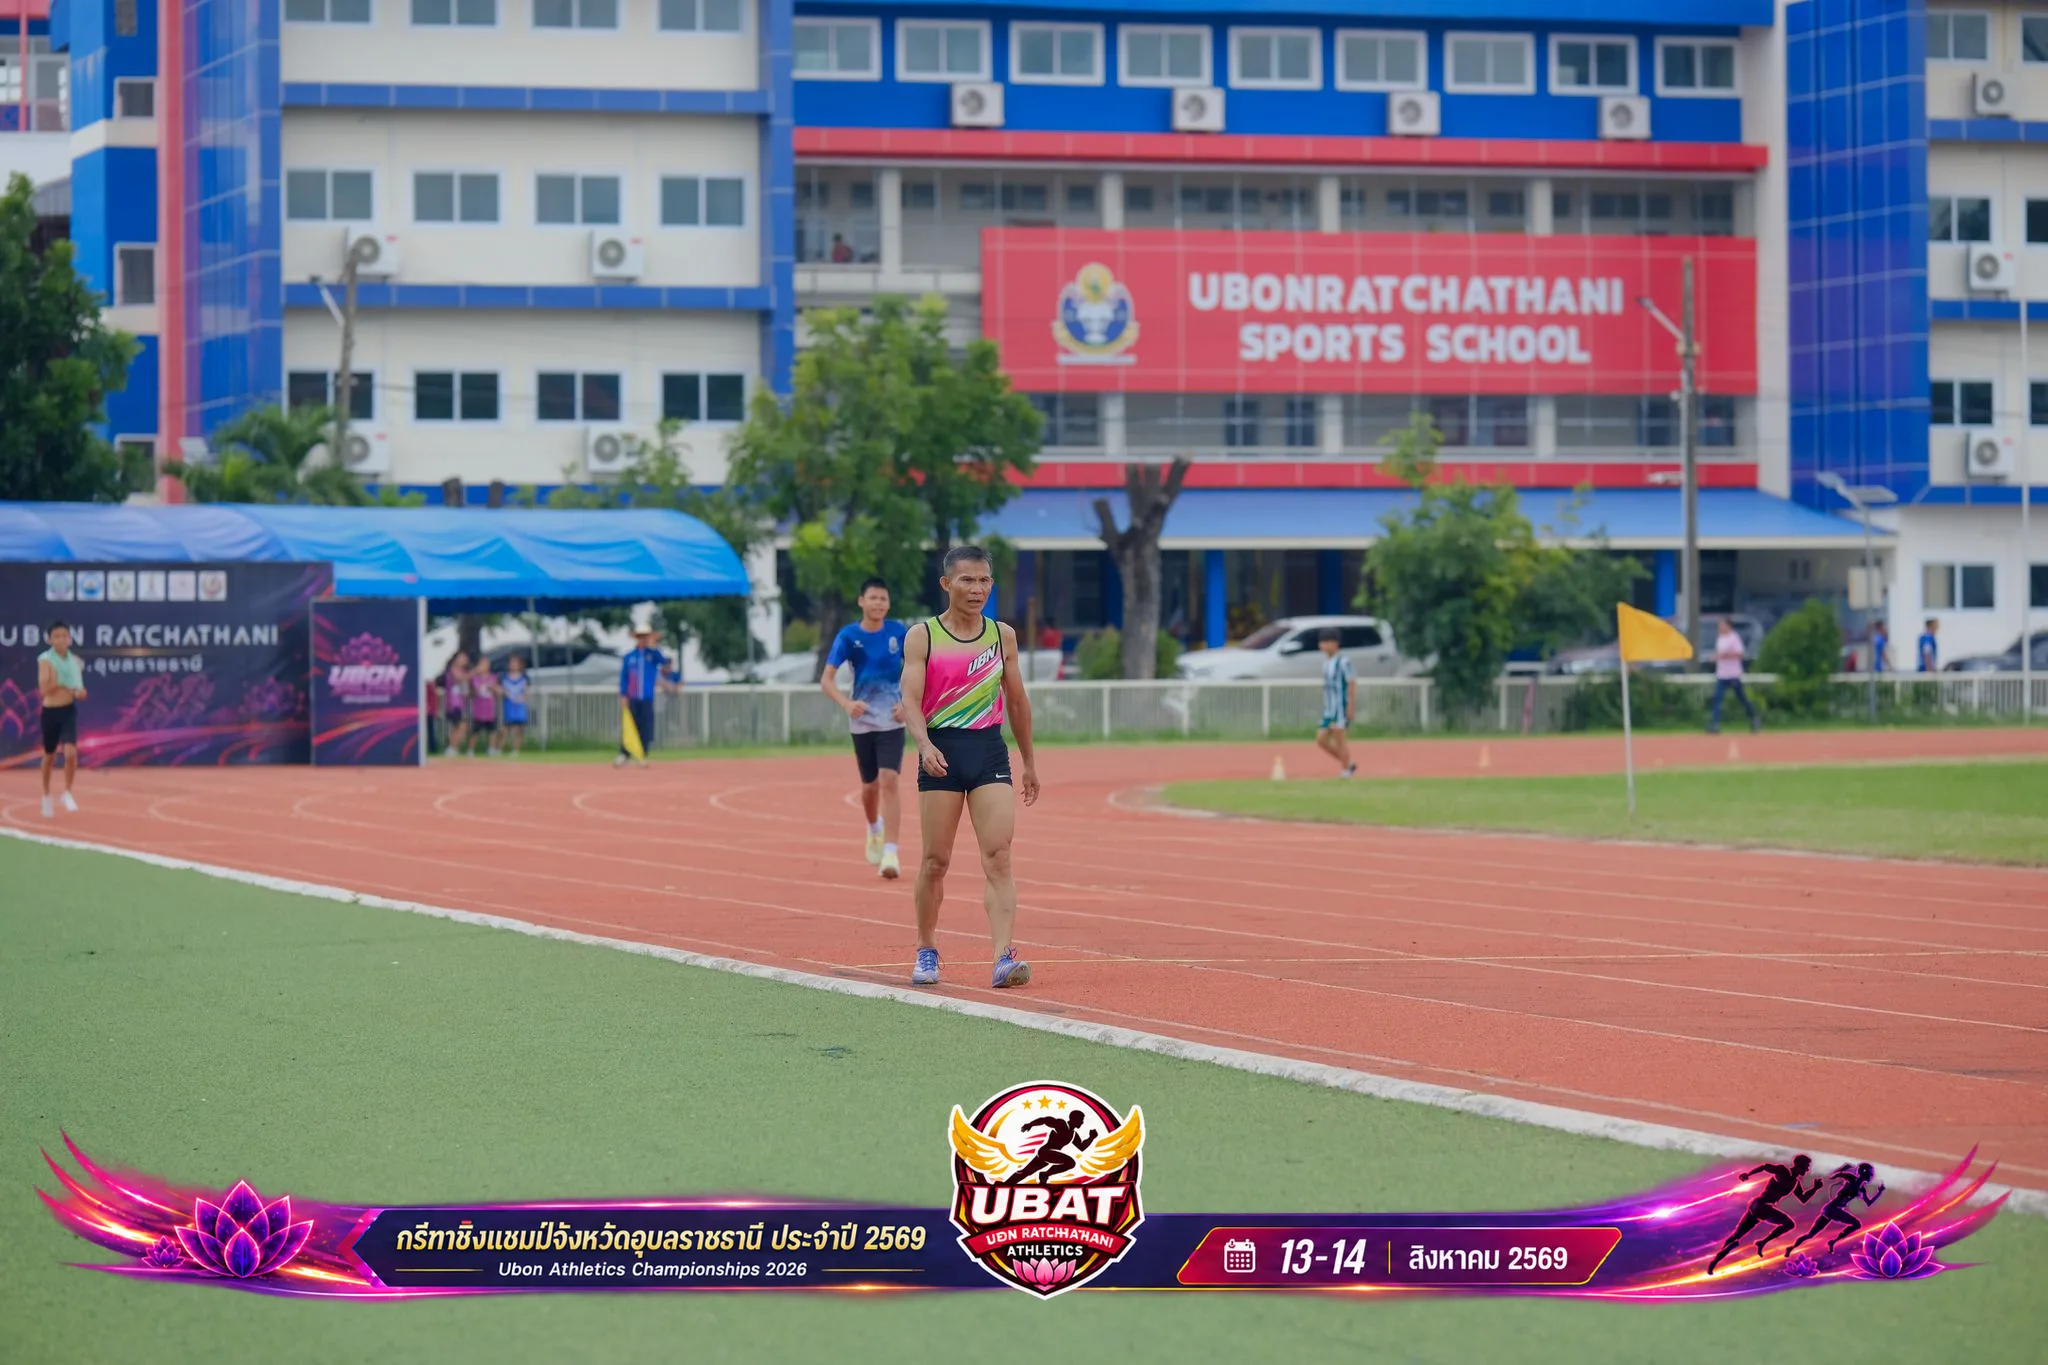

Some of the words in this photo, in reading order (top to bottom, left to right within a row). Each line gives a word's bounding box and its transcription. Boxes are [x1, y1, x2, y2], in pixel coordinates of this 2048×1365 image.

[1189, 272, 1624, 316] UBONRATCHATHANI
[1239, 323, 1405, 362] SPORTS
[1426, 324, 1592, 364] SCHOOL
[96, 624, 278, 647] RATCHATHANI
[967, 643, 997, 676] UBN
